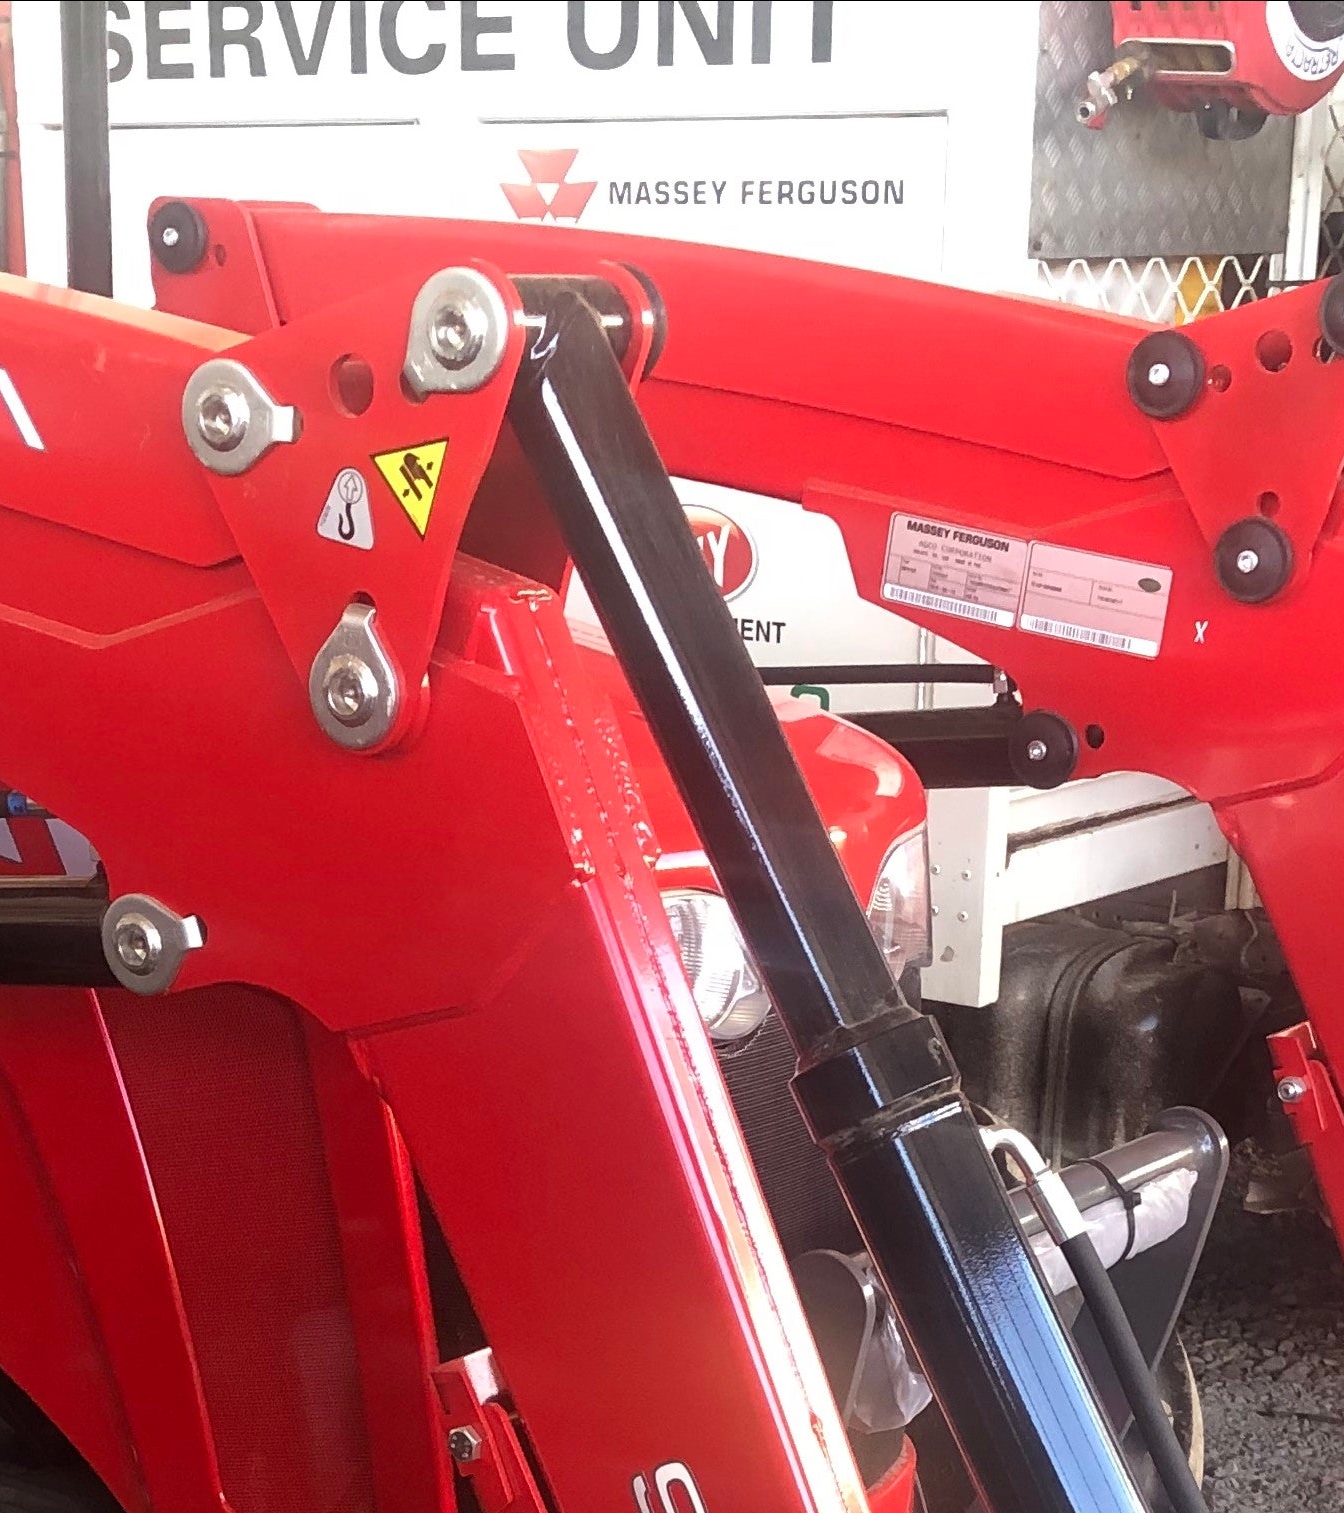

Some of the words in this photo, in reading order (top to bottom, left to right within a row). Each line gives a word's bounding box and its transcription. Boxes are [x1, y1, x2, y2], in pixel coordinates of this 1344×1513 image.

[108, 1, 515, 83] SERVICE
[609, 180, 727, 205] MASSEY
[741, 178, 904, 205] FERGUSON
[907, 520, 950, 539] MASSEY
[953, 530, 1010, 552] FERGUSON
